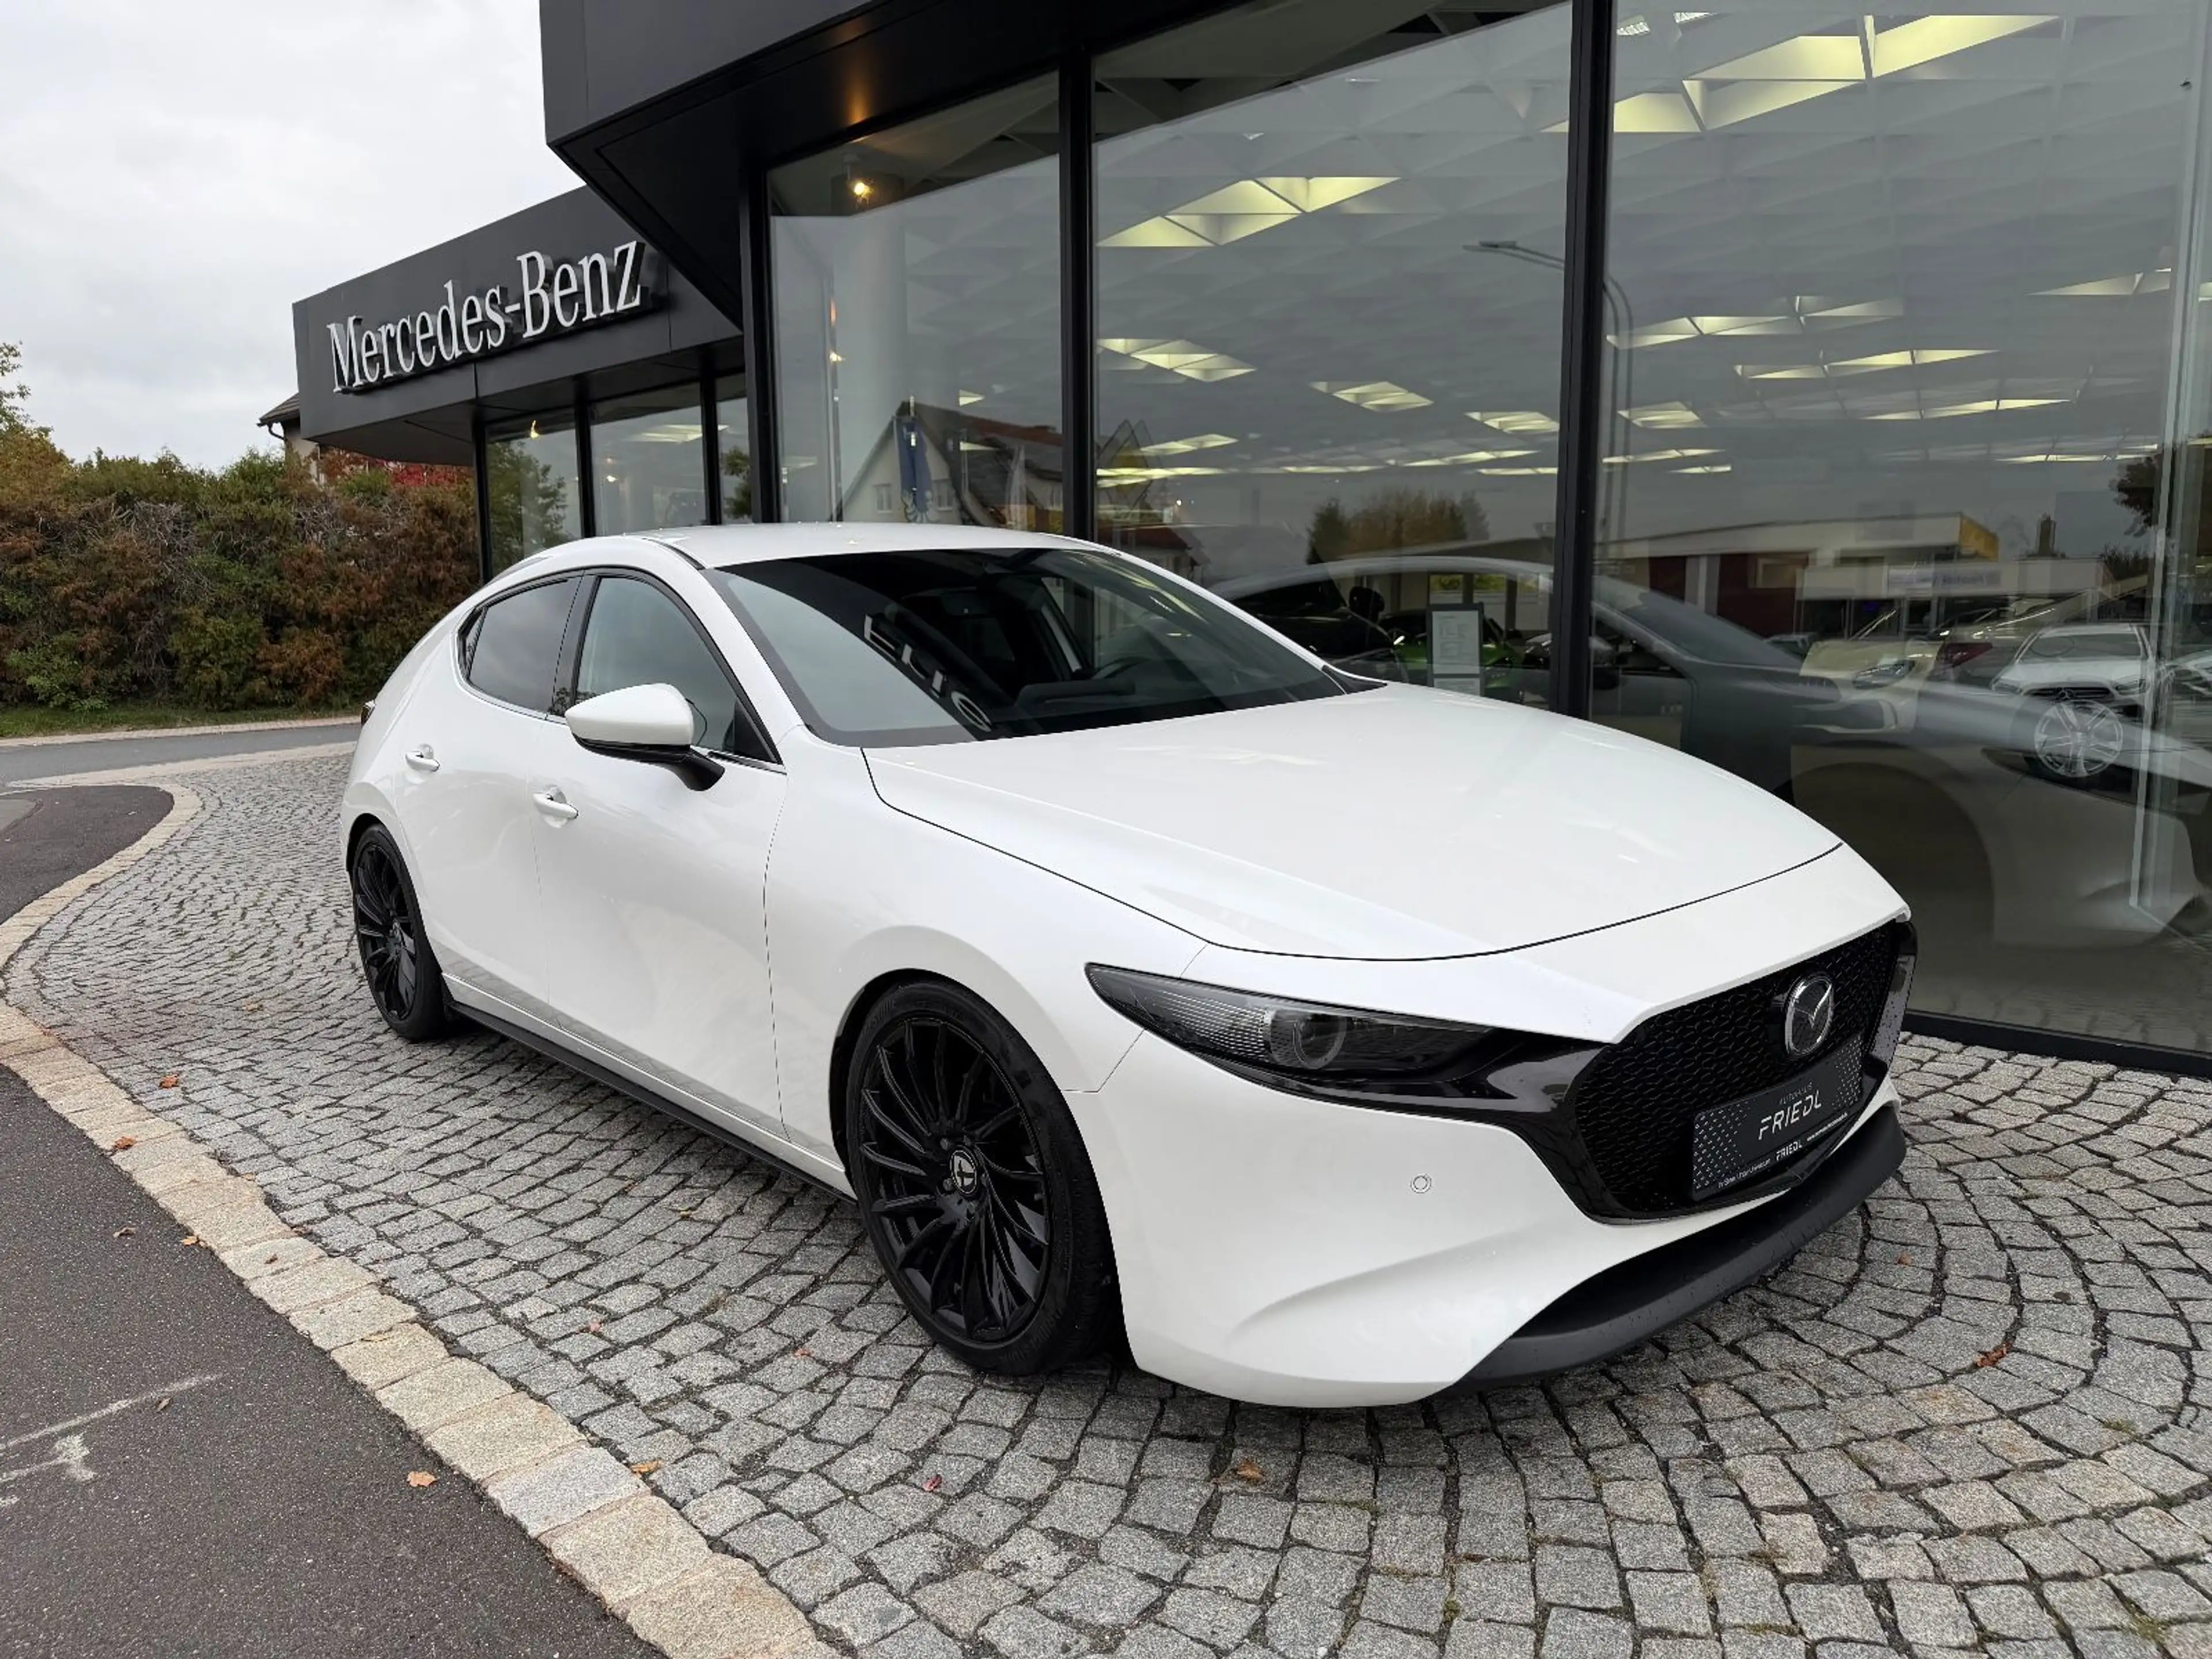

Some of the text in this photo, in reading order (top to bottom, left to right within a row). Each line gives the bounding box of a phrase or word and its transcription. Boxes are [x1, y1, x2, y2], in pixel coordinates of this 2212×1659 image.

[326, 241, 642, 393] Mercedes-Benz
[1758, 1089, 1822, 1141] FRIEDL
[1776, 1138, 1803, 1161] FRIEDL
